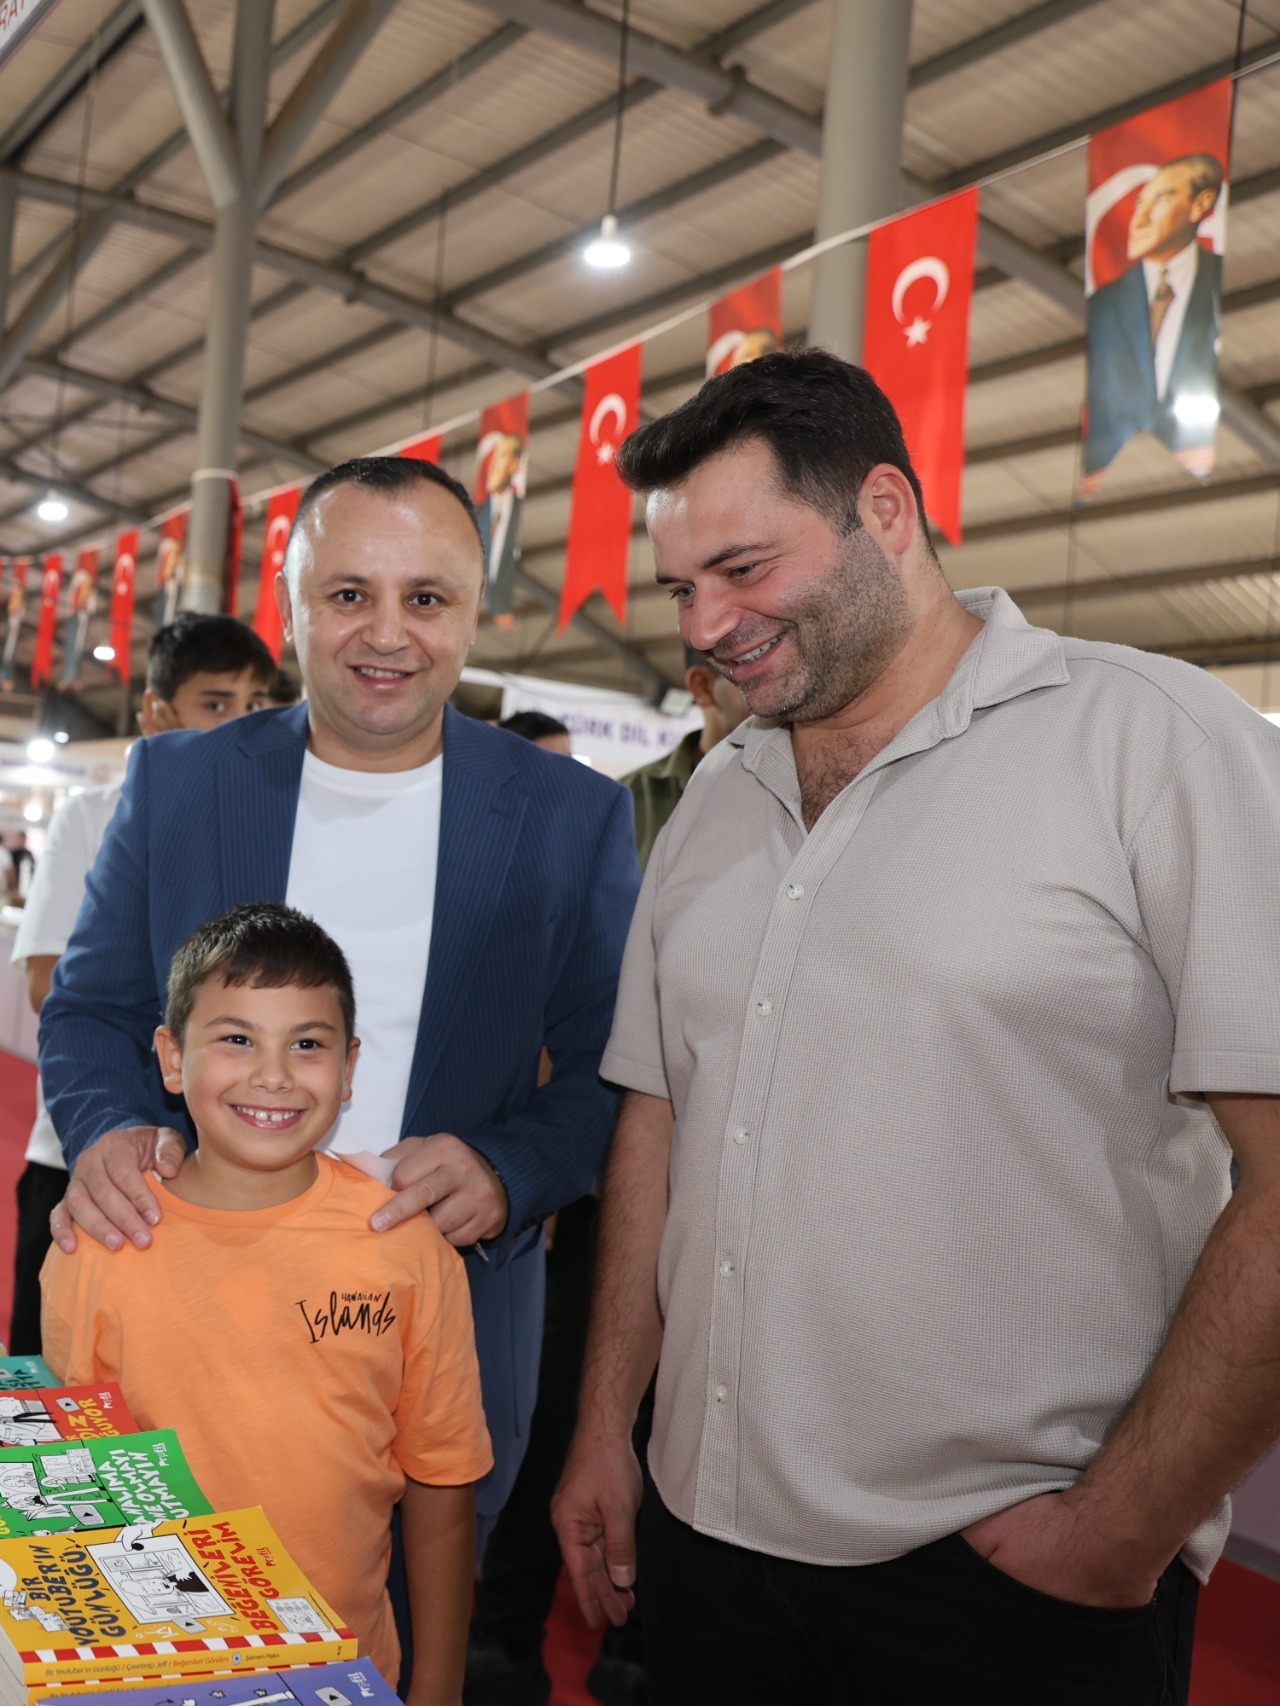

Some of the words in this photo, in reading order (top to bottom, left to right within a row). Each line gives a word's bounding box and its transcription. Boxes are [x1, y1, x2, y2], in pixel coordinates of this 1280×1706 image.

[294, 1290, 396, 1344] Islands
[78, 1397, 120, 1440] ĞUYOR
[98, 1460, 148, 1526] ANALIMA
[127, 1451, 190, 1520] UTMAYIN
[21, 1576, 52, 1602] BİR
[183, 1529, 280, 1632] BEĞENİLERİ
[212, 1521, 280, 1599] GÖRELİM
[58, 1550, 126, 1638] GÜNLÜĞÜ
[45, 1668, 55, 1676] Bir
